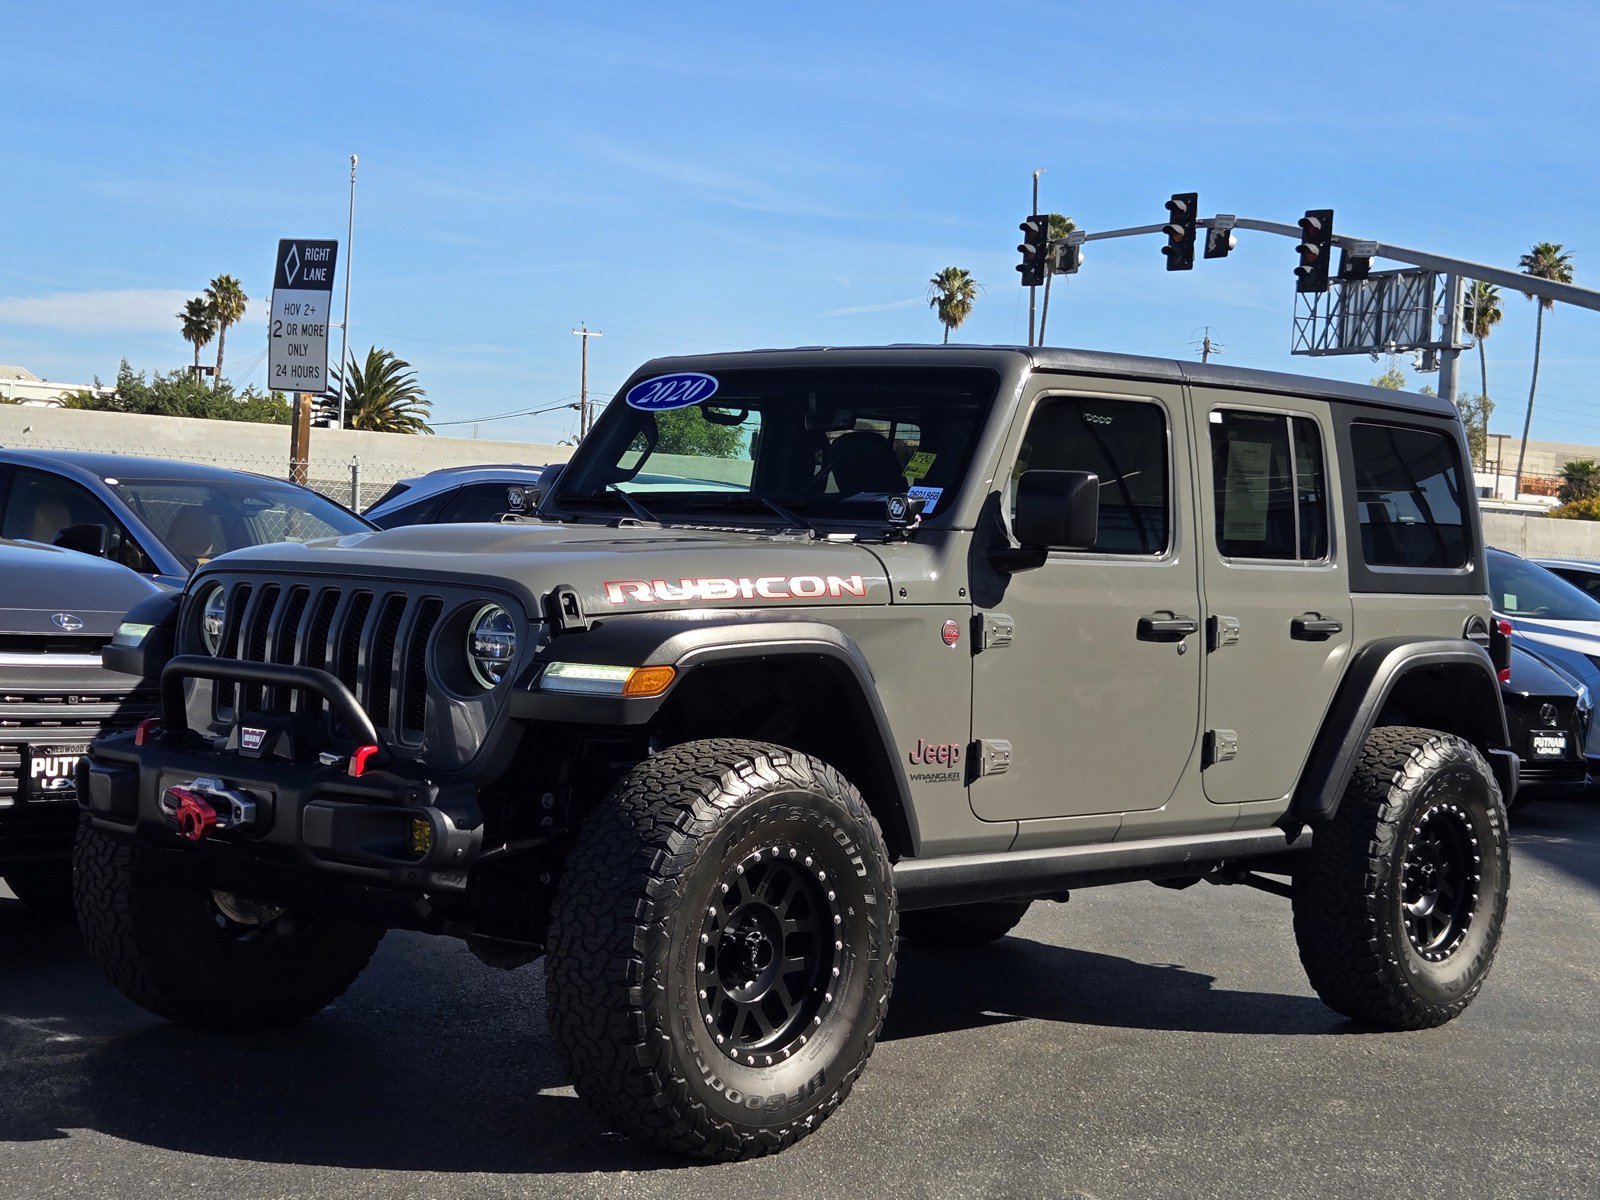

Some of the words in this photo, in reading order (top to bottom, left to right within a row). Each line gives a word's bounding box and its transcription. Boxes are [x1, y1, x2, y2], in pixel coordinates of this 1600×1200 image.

[304, 248, 331, 262] RIGHT
[303, 268, 327, 282] LANE
[284, 303, 302, 316] HOV
[303, 304, 316, 317] 2+
[273, 319, 283, 338] 2
[286, 323, 298, 337] OR
[301, 324, 325, 338] MORE
[287, 343, 309, 357] ONLY
[275, 363, 287, 377] 24
[291, 364, 320, 379] HOURS
[635, 379, 707, 404] 2020
[603, 575, 867, 604] RUBICON
[1533, 736, 1567, 749] PUTNAM
[909, 738, 959, 768] Jeep
[910, 772, 960, 781] WRANGLER
